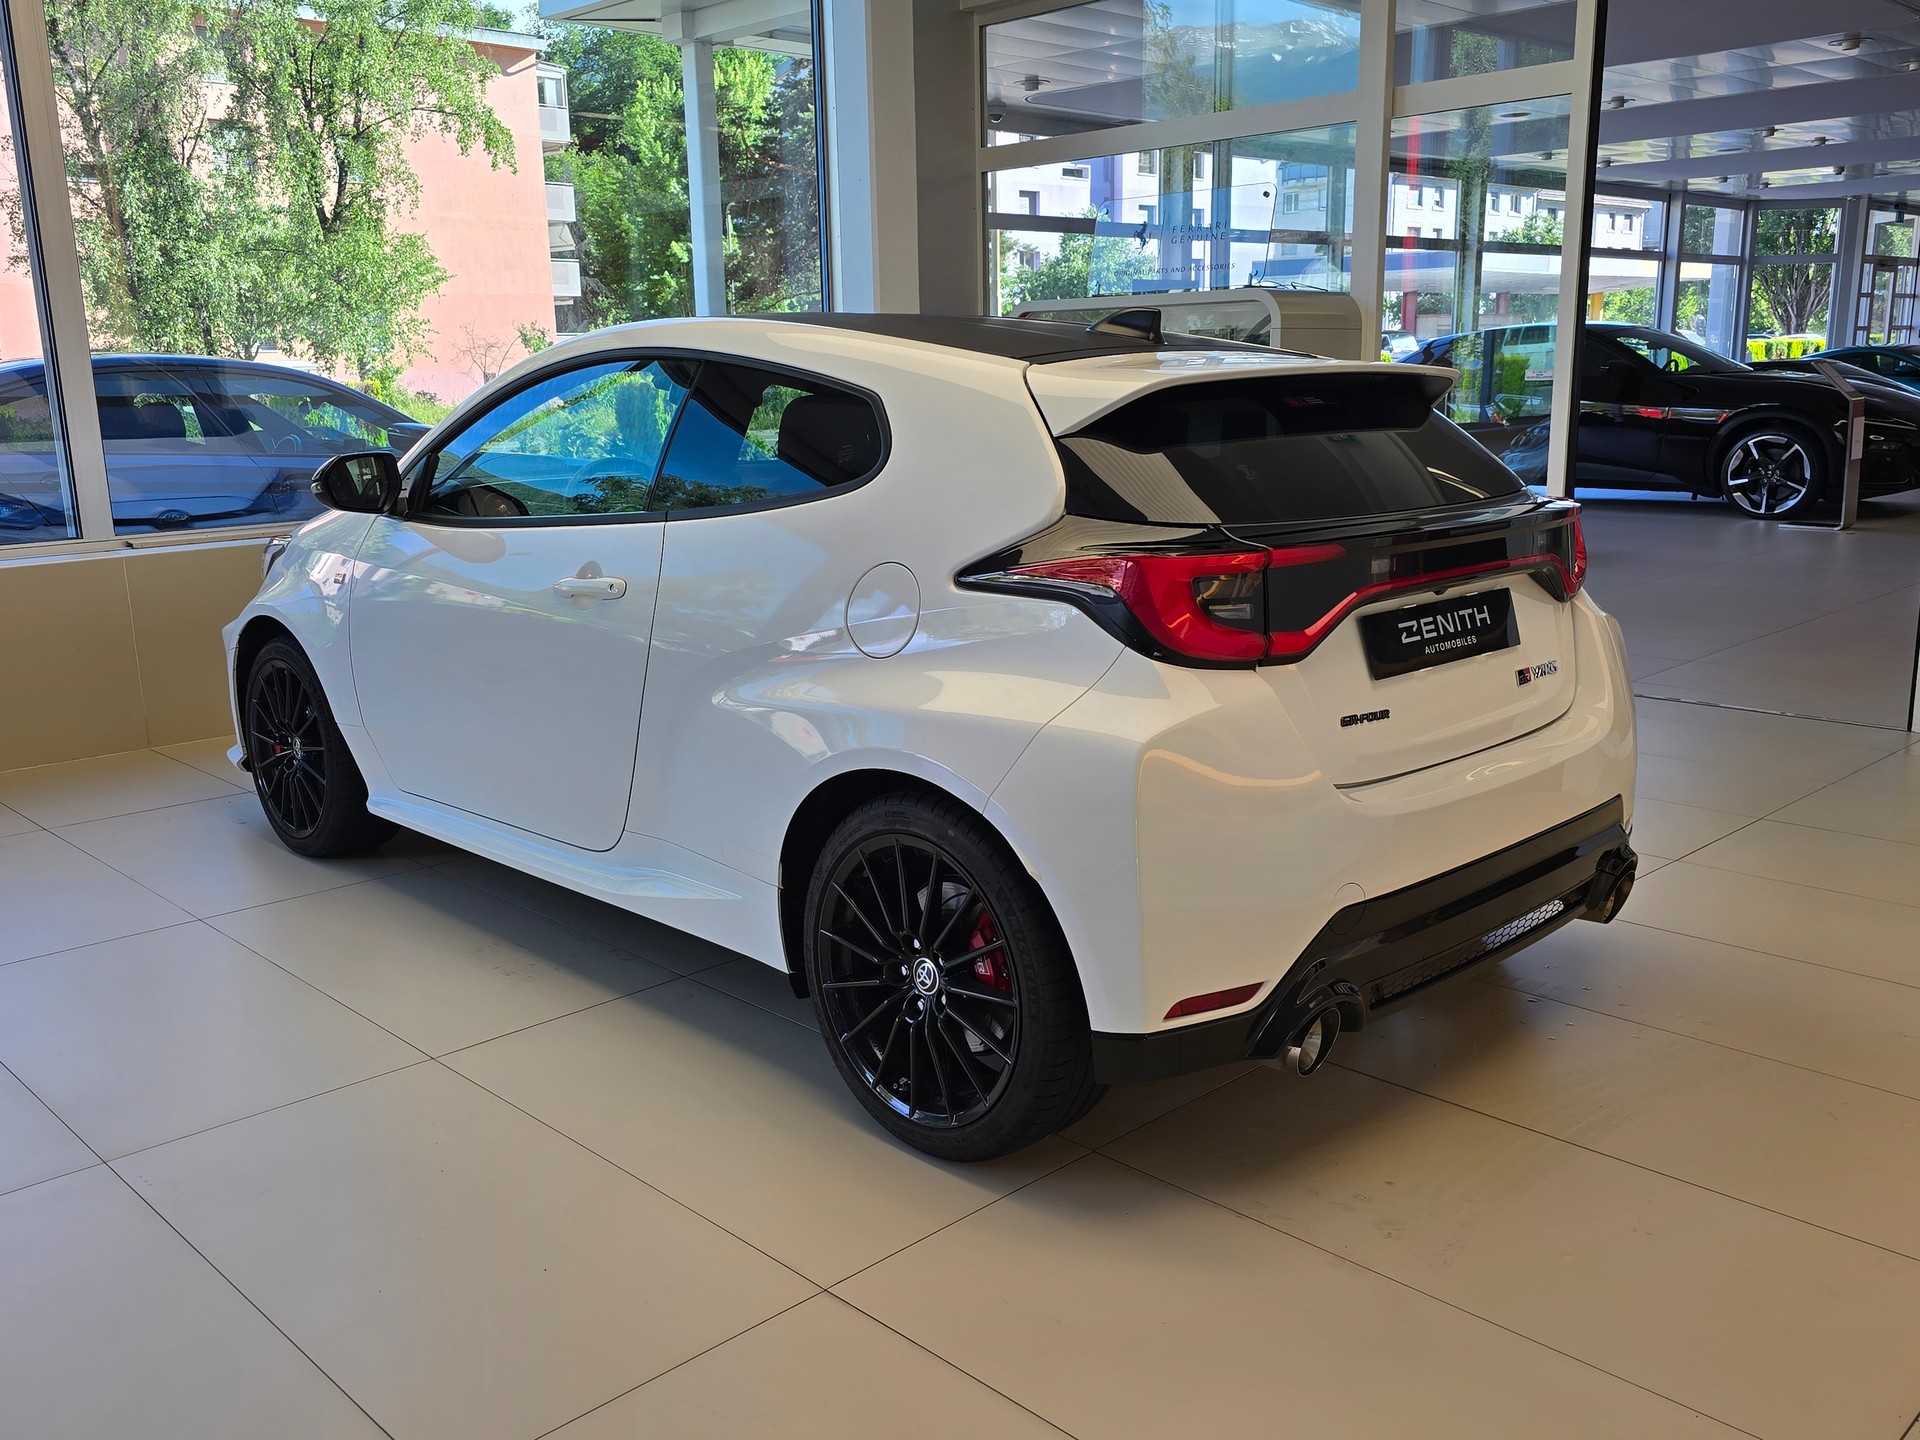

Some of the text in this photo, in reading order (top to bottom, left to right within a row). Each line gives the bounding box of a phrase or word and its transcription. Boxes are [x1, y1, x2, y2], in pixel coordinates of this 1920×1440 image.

[1172, 221, 1228, 234] FERRARI
[1171, 232, 1226, 244] GENUINE
[1114, 269, 1147, 278] ORIGINAL
[1148, 267, 1169, 275] PARTS
[1187, 263, 1236, 272] ACCESSORIES
[1398, 605, 1491, 644] ZENITH
[1425, 635, 1478, 655] AUTOMOBILES
[1007, 915, 1038, 1017] MICHELIN
